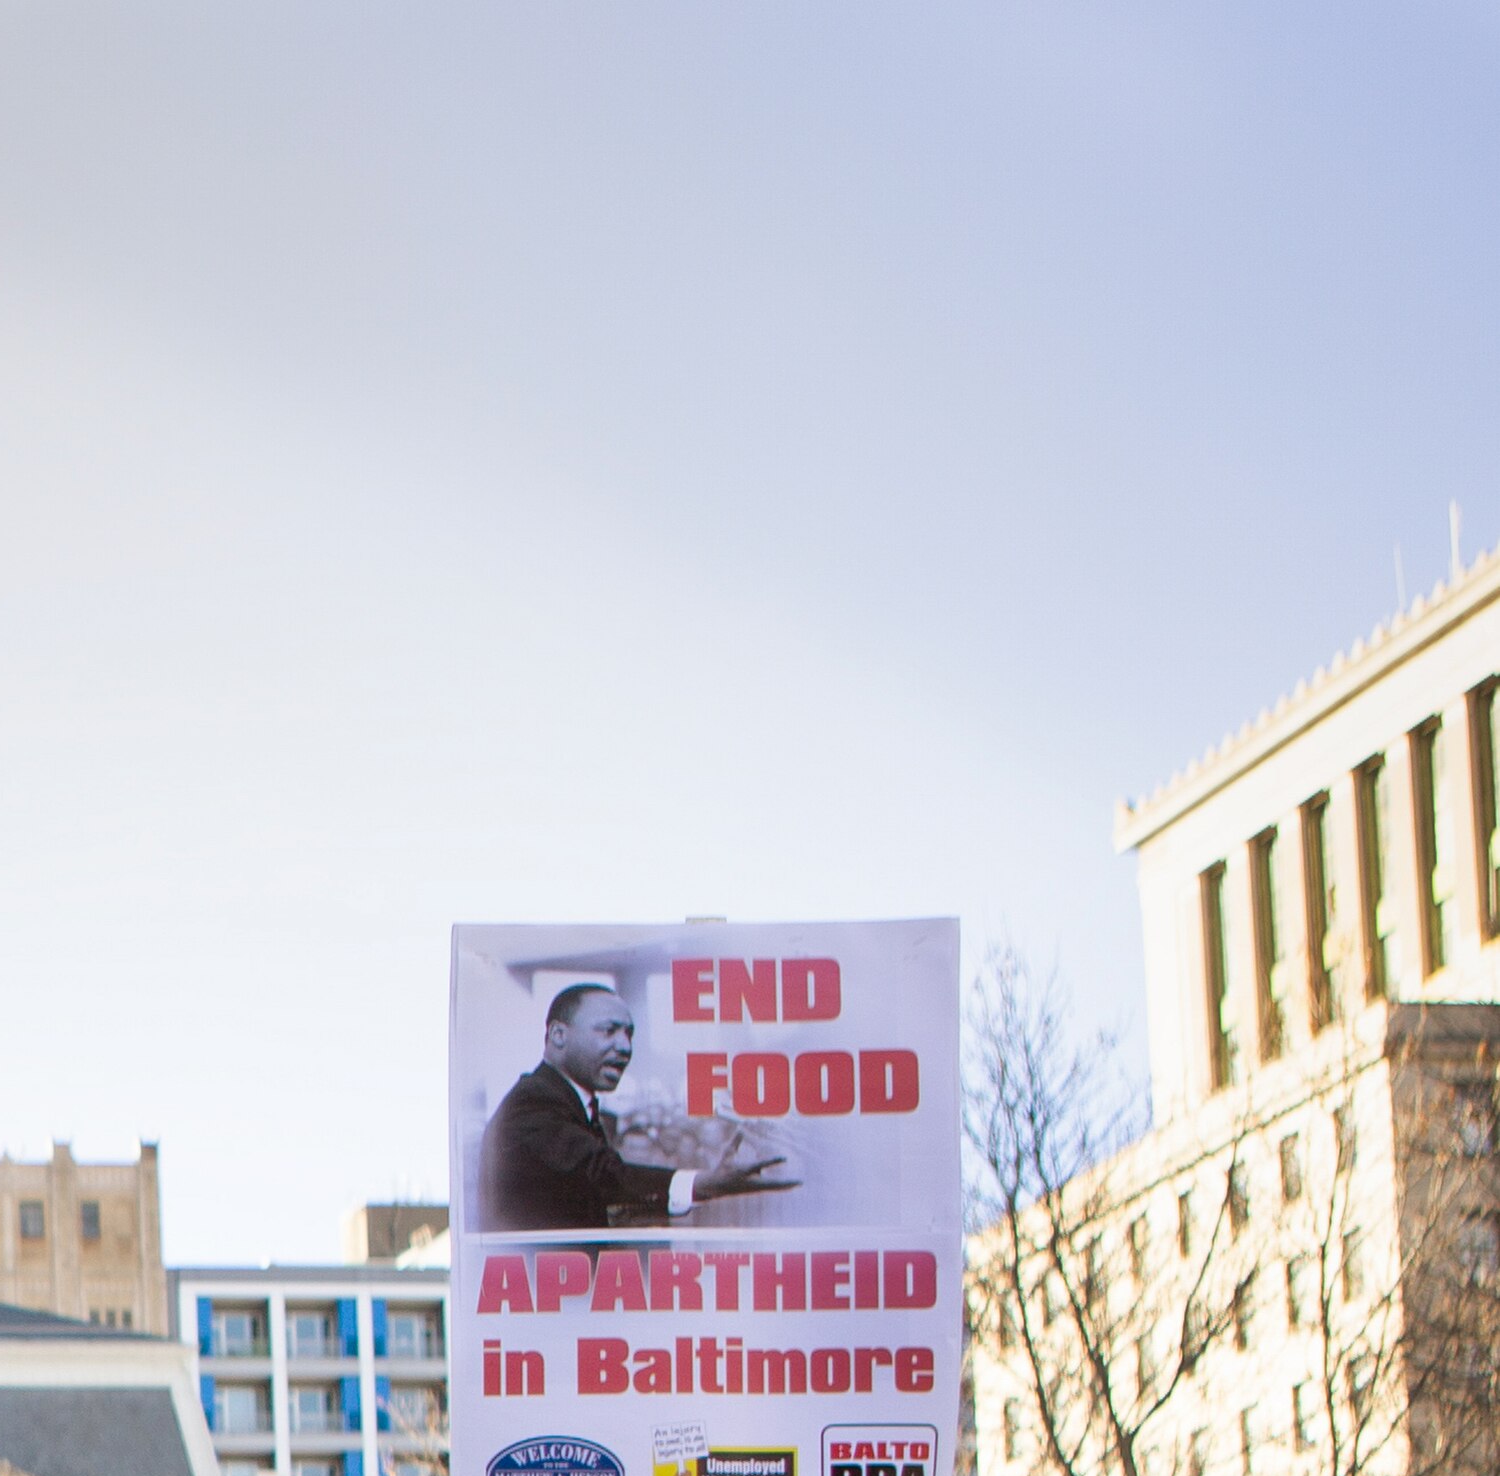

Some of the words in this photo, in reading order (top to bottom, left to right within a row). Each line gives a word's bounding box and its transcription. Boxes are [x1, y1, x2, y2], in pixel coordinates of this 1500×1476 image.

[672, 957, 842, 1023] END
[686, 1049, 920, 1117] FOOD
[477, 1250, 938, 1315] APARTHEID
[483, 1339, 546, 1397] in
[577, 1337, 935, 1396] Baltimore
[509, 1444, 602, 1469] WELCOME
[706, 1458, 785, 1476] Unemployed
[830, 1442, 929, 1460] BALTO
